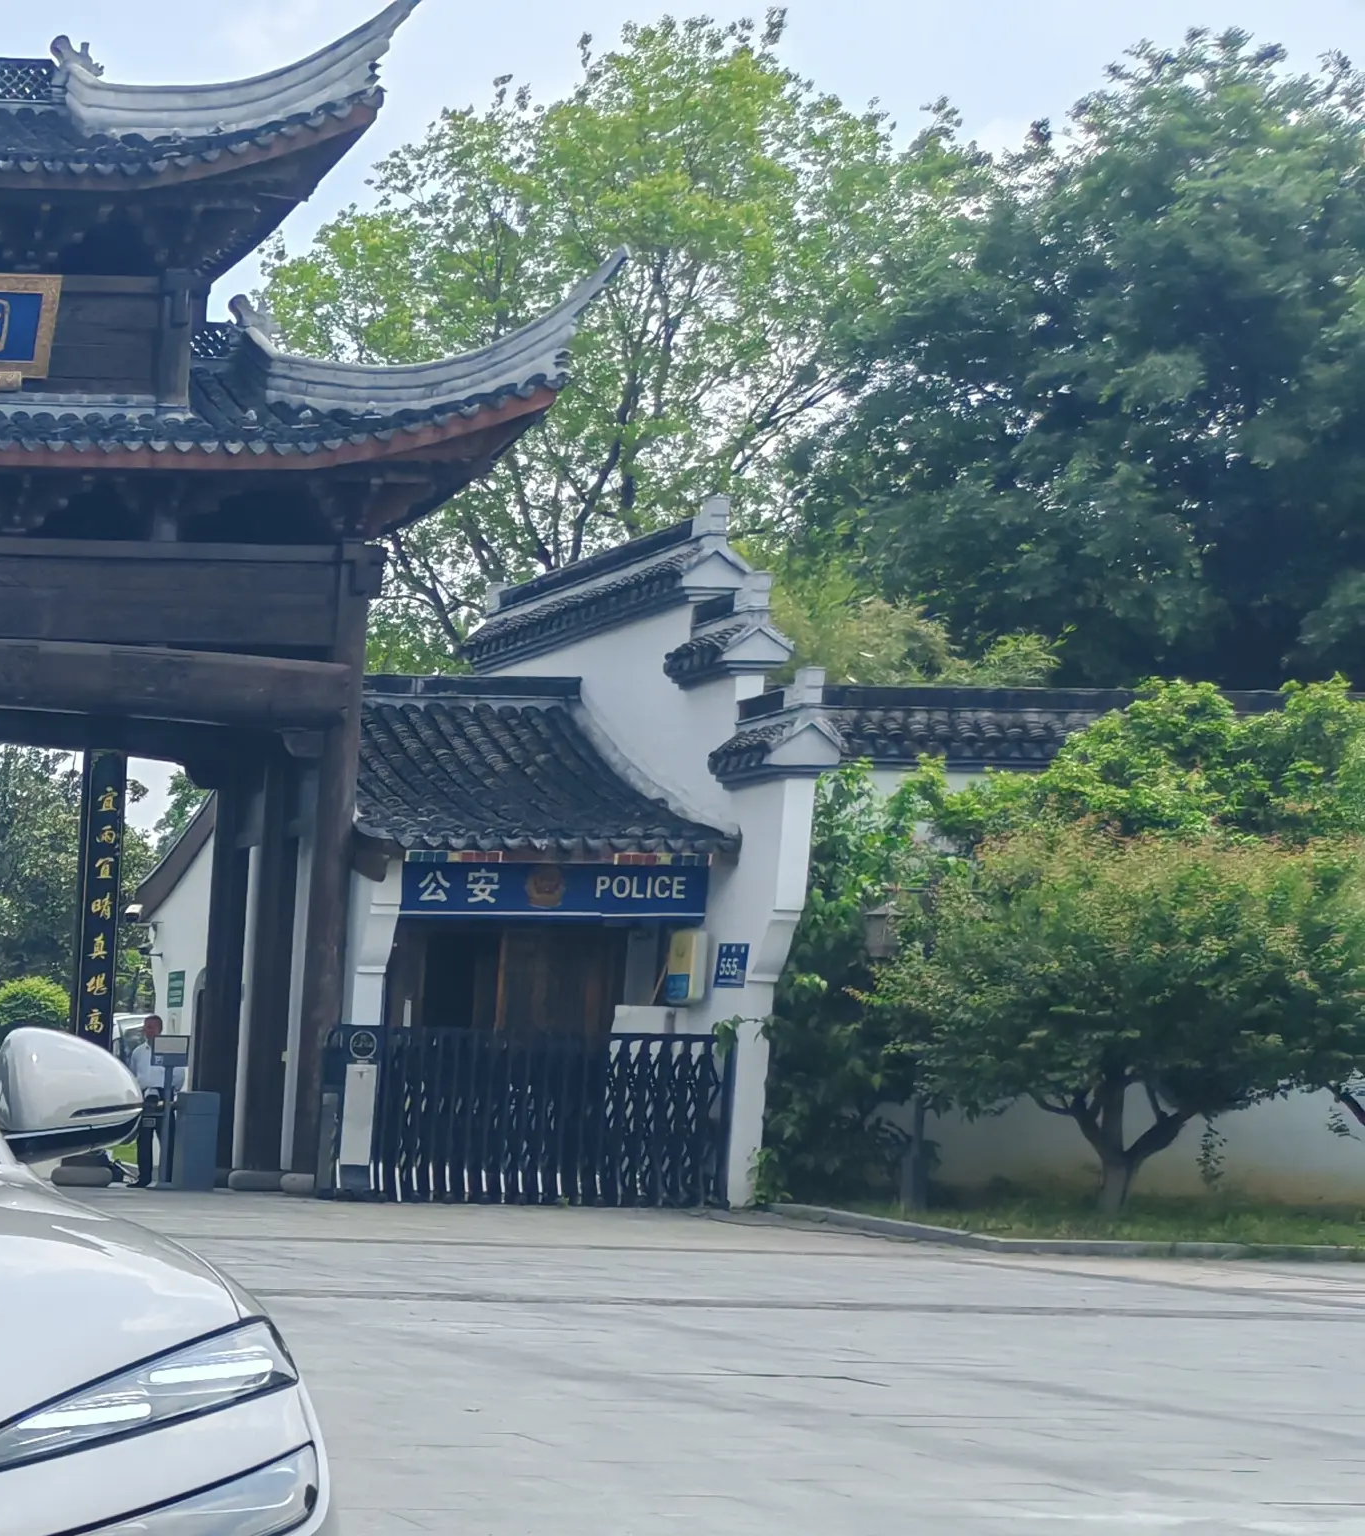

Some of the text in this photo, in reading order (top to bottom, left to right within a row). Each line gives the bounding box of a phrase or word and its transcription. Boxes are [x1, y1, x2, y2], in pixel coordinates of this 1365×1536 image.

[419, 868, 500, 903] 公安
[595, 875, 687, 900] POLICE
[719, 956, 740, 976] 555
